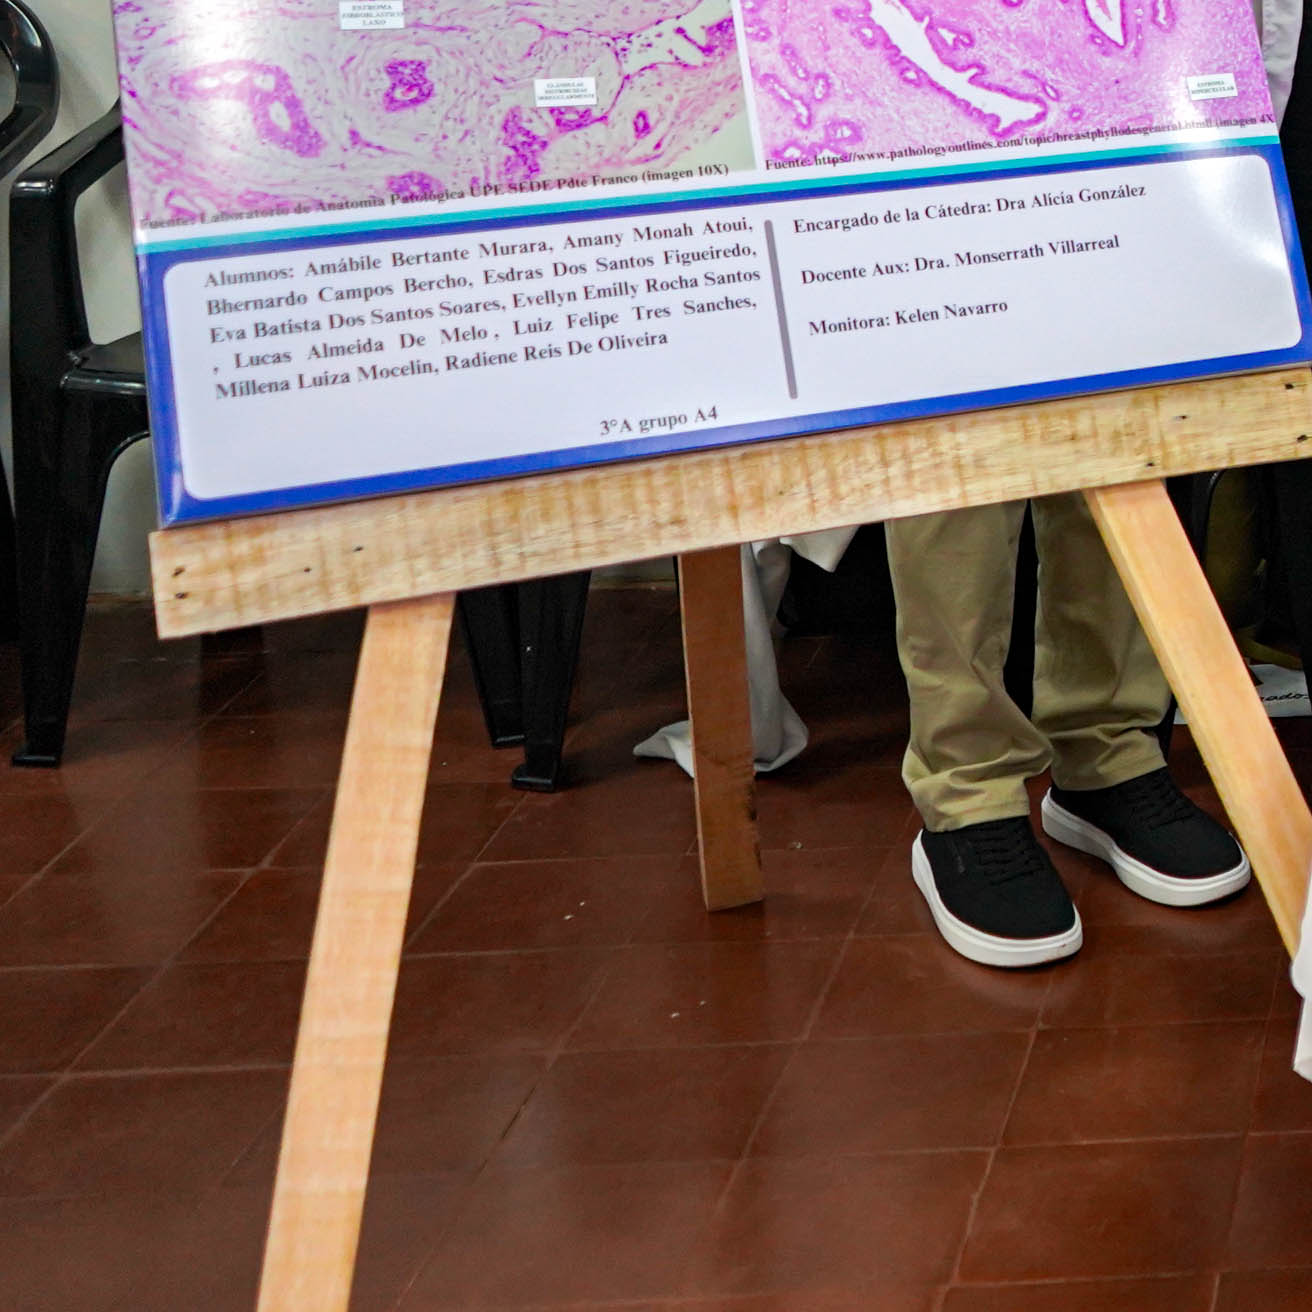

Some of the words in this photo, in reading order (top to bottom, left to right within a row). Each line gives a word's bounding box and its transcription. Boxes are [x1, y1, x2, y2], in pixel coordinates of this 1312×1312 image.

[794, 212, 879, 233] Encargado
[884, 209, 901, 224] de
[906, 208, 920, 221] la
[925, 201, 992, 219] Cátedra:
[997, 198, 1026, 212] Dra
[1030, 192, 1075, 208] Alicia
[1079, 184, 1146, 202] González
[207, 268, 294, 286] Alumnos:
[304, 256, 382, 276] Amábile
[392, 249, 470, 267] Bertante
[478, 241, 554, 257] Murara,
[562, 234, 623, 249] Amany
[632, 222, 694, 241] Monah
[702, 216, 753, 234] Atoui,
[208, 291, 308, 315] Bhernardo
[318, 285, 394, 302] Campos
[404, 274, 473, 293] Bercho,
[484, 267, 544, 284] Esdras
[553, 262, 588, 277] Dos
[596, 256, 655, 272] Santos
[664, 243, 757, 266] Figueiredo,
[802, 267, 867, 284] Docente
[872, 263, 910, 275] Aux:
[915, 257, 950, 271] Dra.
[953, 244, 1044, 265] Monserrath
[1049, 235, 1120, 254] Villarreal
[211, 327, 247, 344] Eva
[254, 319, 322, 338] Batista
[329, 313, 366, 329] Dos
[371, 308, 434, 324] Santos
[440, 300, 506, 316] Soares,
[513, 289, 577, 308] Evellyn
[584, 281, 637, 300] Emilly
[646, 275, 699, 293] Rocha
[704, 271, 761, 286] Santos
[235, 351, 292, 369] Lucas
[307, 338, 384, 359] Almeida
[400, 333, 426, 349] De
[439, 325, 488, 342] Melo
[514, 317, 553, 335] Luiz
[567, 311, 619, 329] Felipe
[632, 305, 672, 321] Tres
[683, 295, 757, 315] Sanches,
[808, 316, 890, 334] Monitora:
[896, 308, 940, 325] Kelen
[944, 302, 1008, 318] Navarro
[215, 379, 291, 397] Millena
[299, 370, 351, 389] Luiza
[356, 360, 439, 380] Mocelin,
[446, 352, 518, 371] Radiene
[524, 343, 562, 361] Reis
[568, 340, 593, 356] De
[598, 331, 668, 351] Oliveira
[639, 414, 688, 433] grupo
[694, 405, 718, 422] A4
